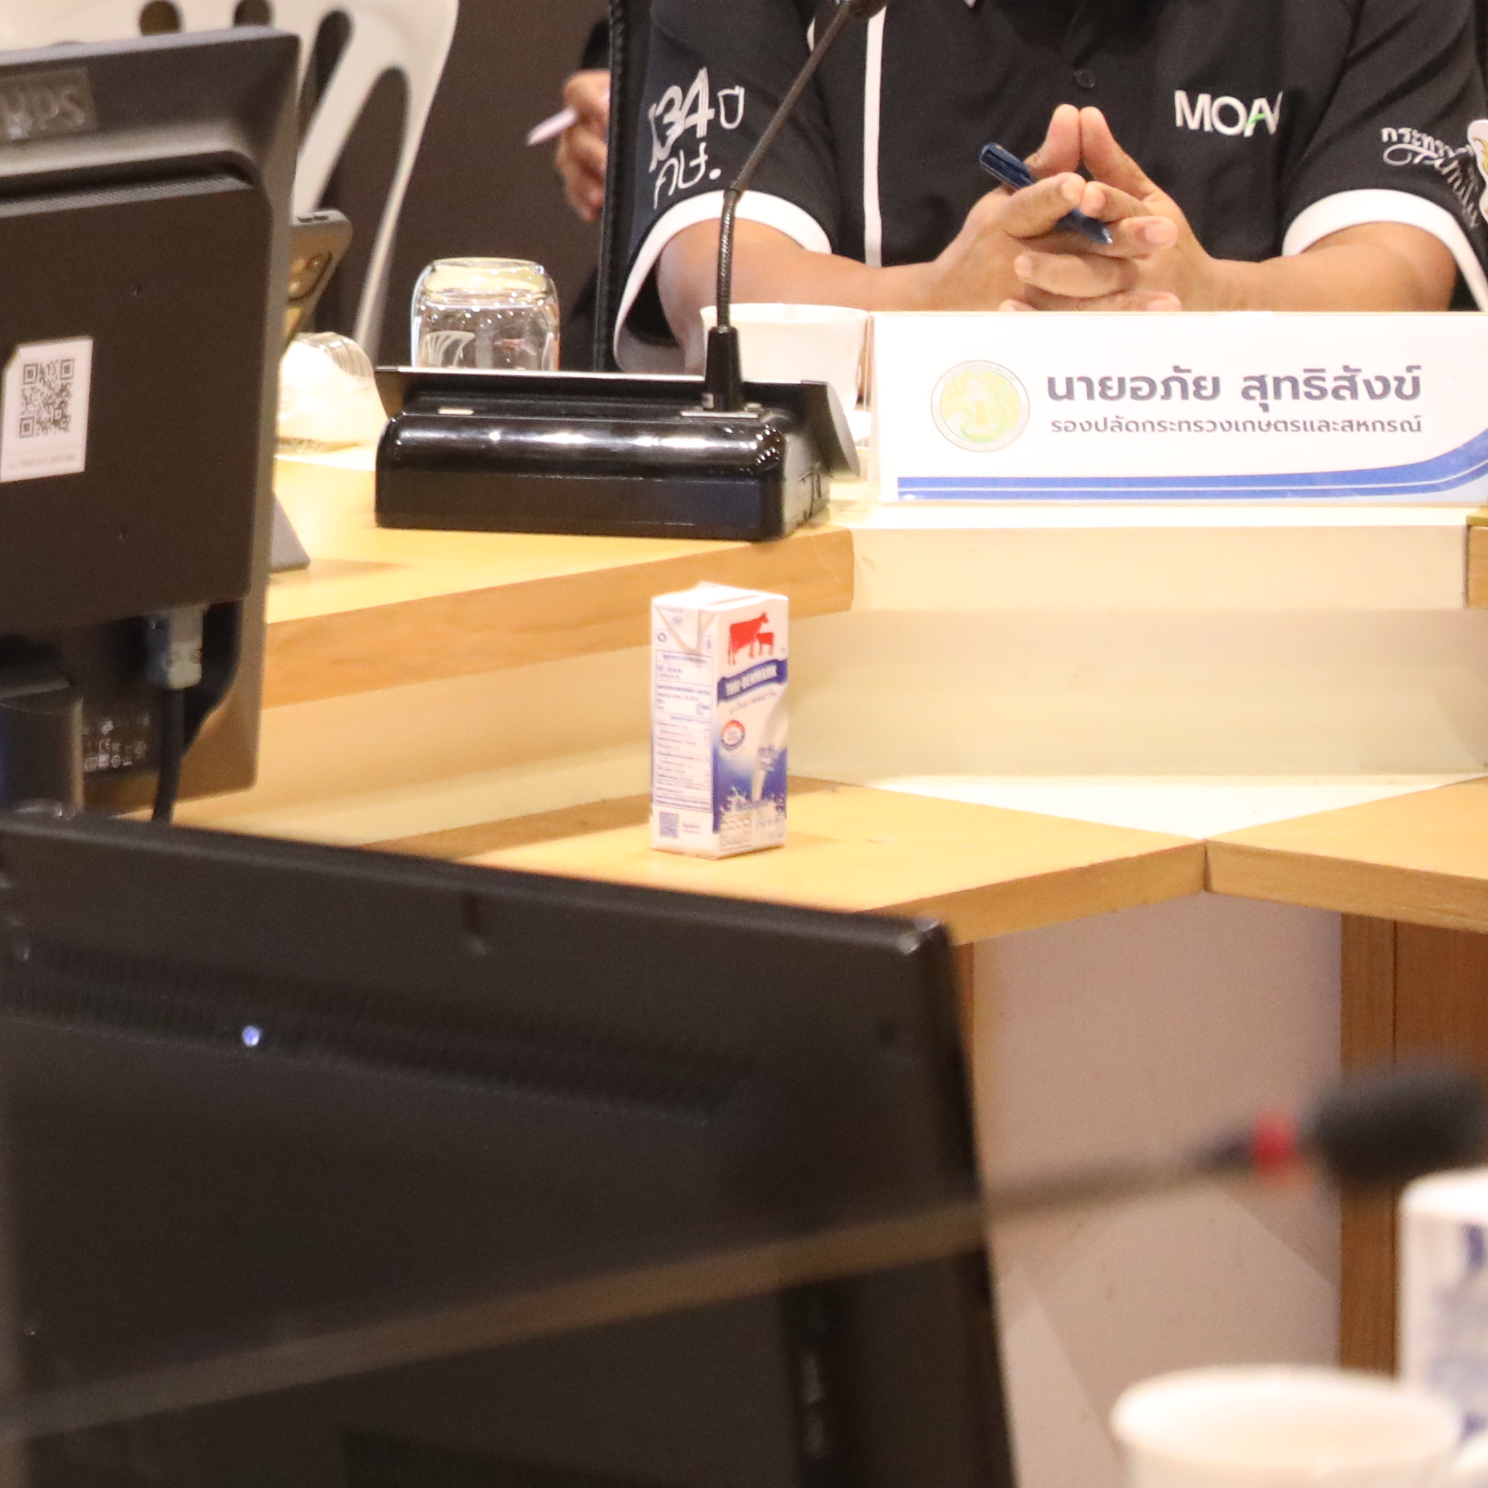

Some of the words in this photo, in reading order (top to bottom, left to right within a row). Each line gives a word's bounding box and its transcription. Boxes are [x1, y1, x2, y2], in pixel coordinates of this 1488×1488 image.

[1046, 364, 1222, 402] นายอภัย
[1240, 364, 1423, 413] สุทธิสังข์
[1050, 414, 1423, 434] รองปลัดกระทรวงเกษตรและสหกรณ์
